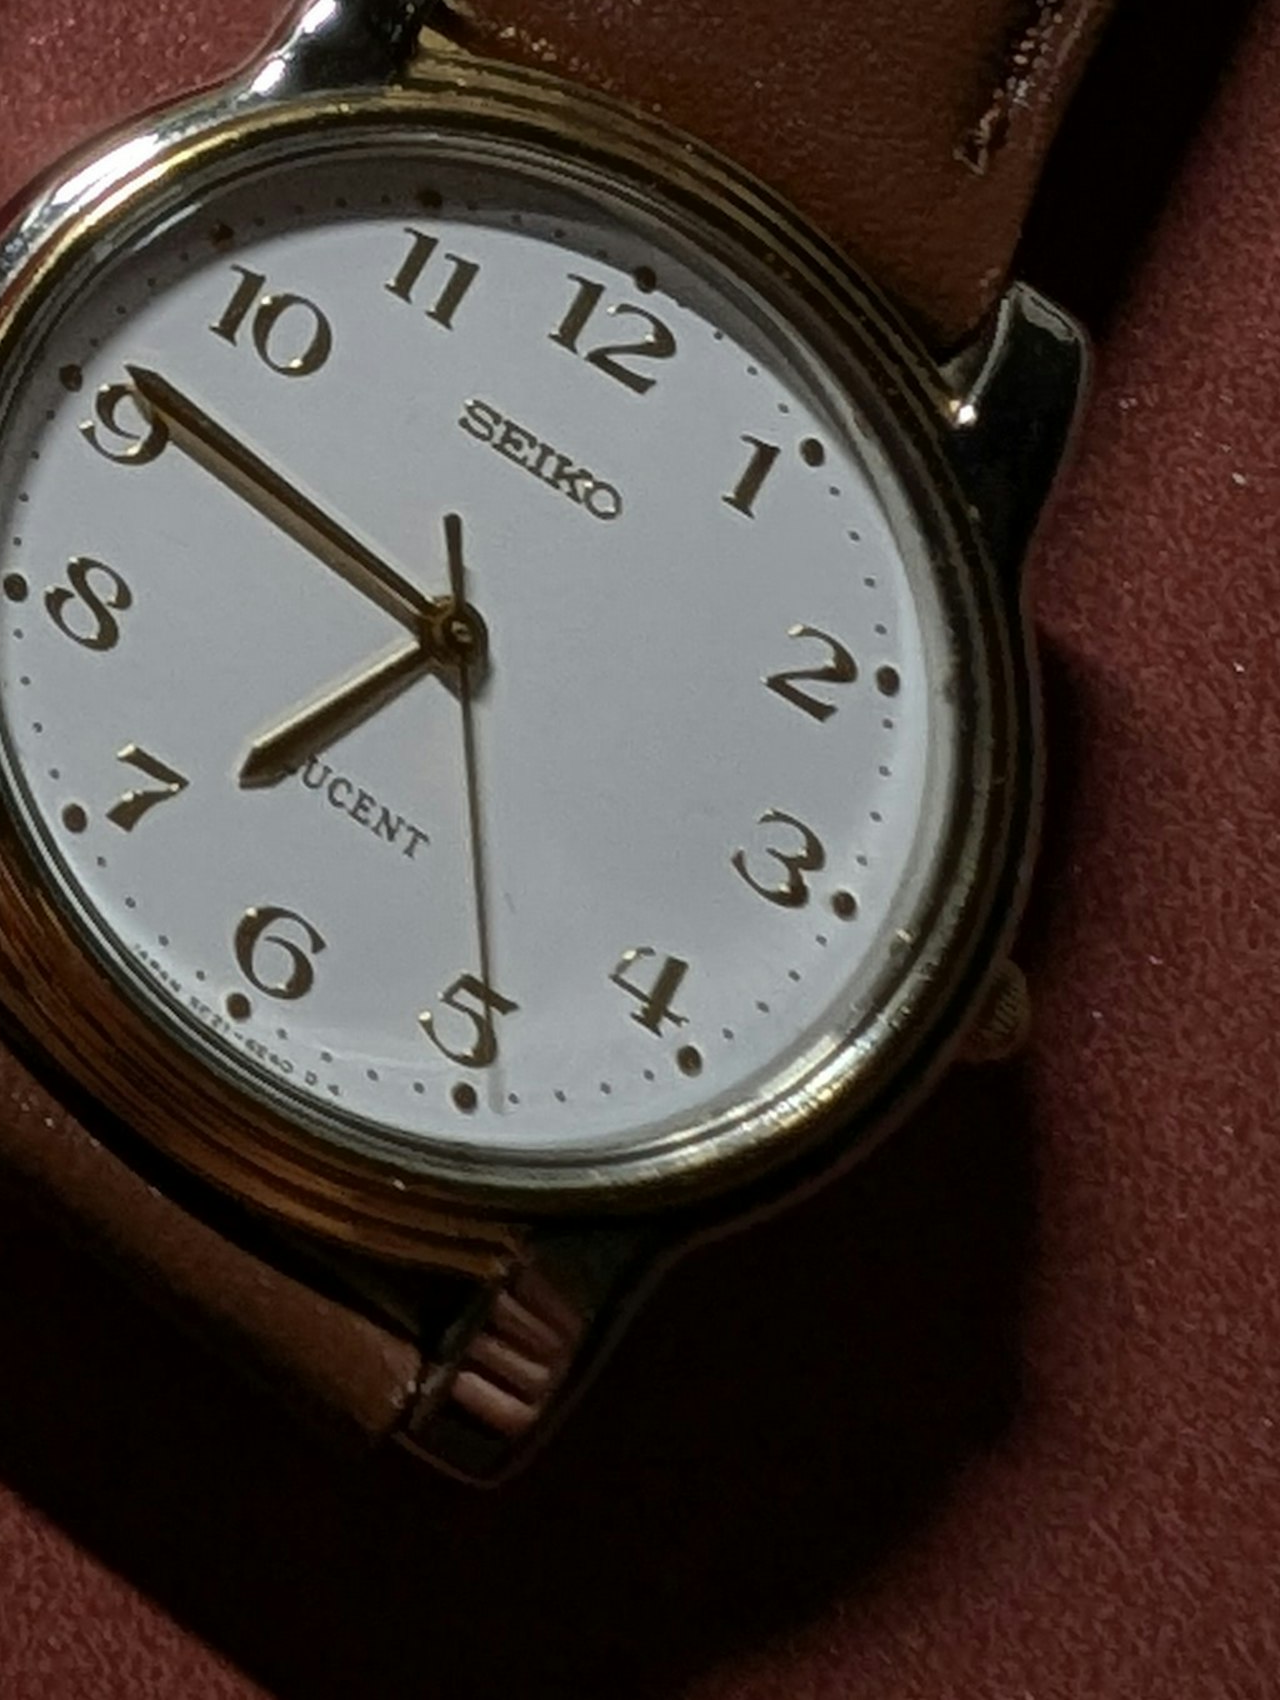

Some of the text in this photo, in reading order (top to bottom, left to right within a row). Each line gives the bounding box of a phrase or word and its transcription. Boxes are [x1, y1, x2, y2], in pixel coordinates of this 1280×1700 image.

[209, 264, 333, 377] 10
[384, 227, 481, 331] 11
[547, 273, 678, 395] 12
[78, 383, 170, 467] 9
[458, 400, 622, 521] SEIKO
[721, 433, 781, 520] 1
[44, 556, 133, 652] 8
[760, 623, 859, 720] 2
[105, 744, 190, 833] 7
[279, 753, 431, 861] UCENT
[731, 808, 826, 909] 3
[234, 905, 327, 1001] 6
[609, 946, 690, 1038] 4
[418, 973, 520, 1069] 5
